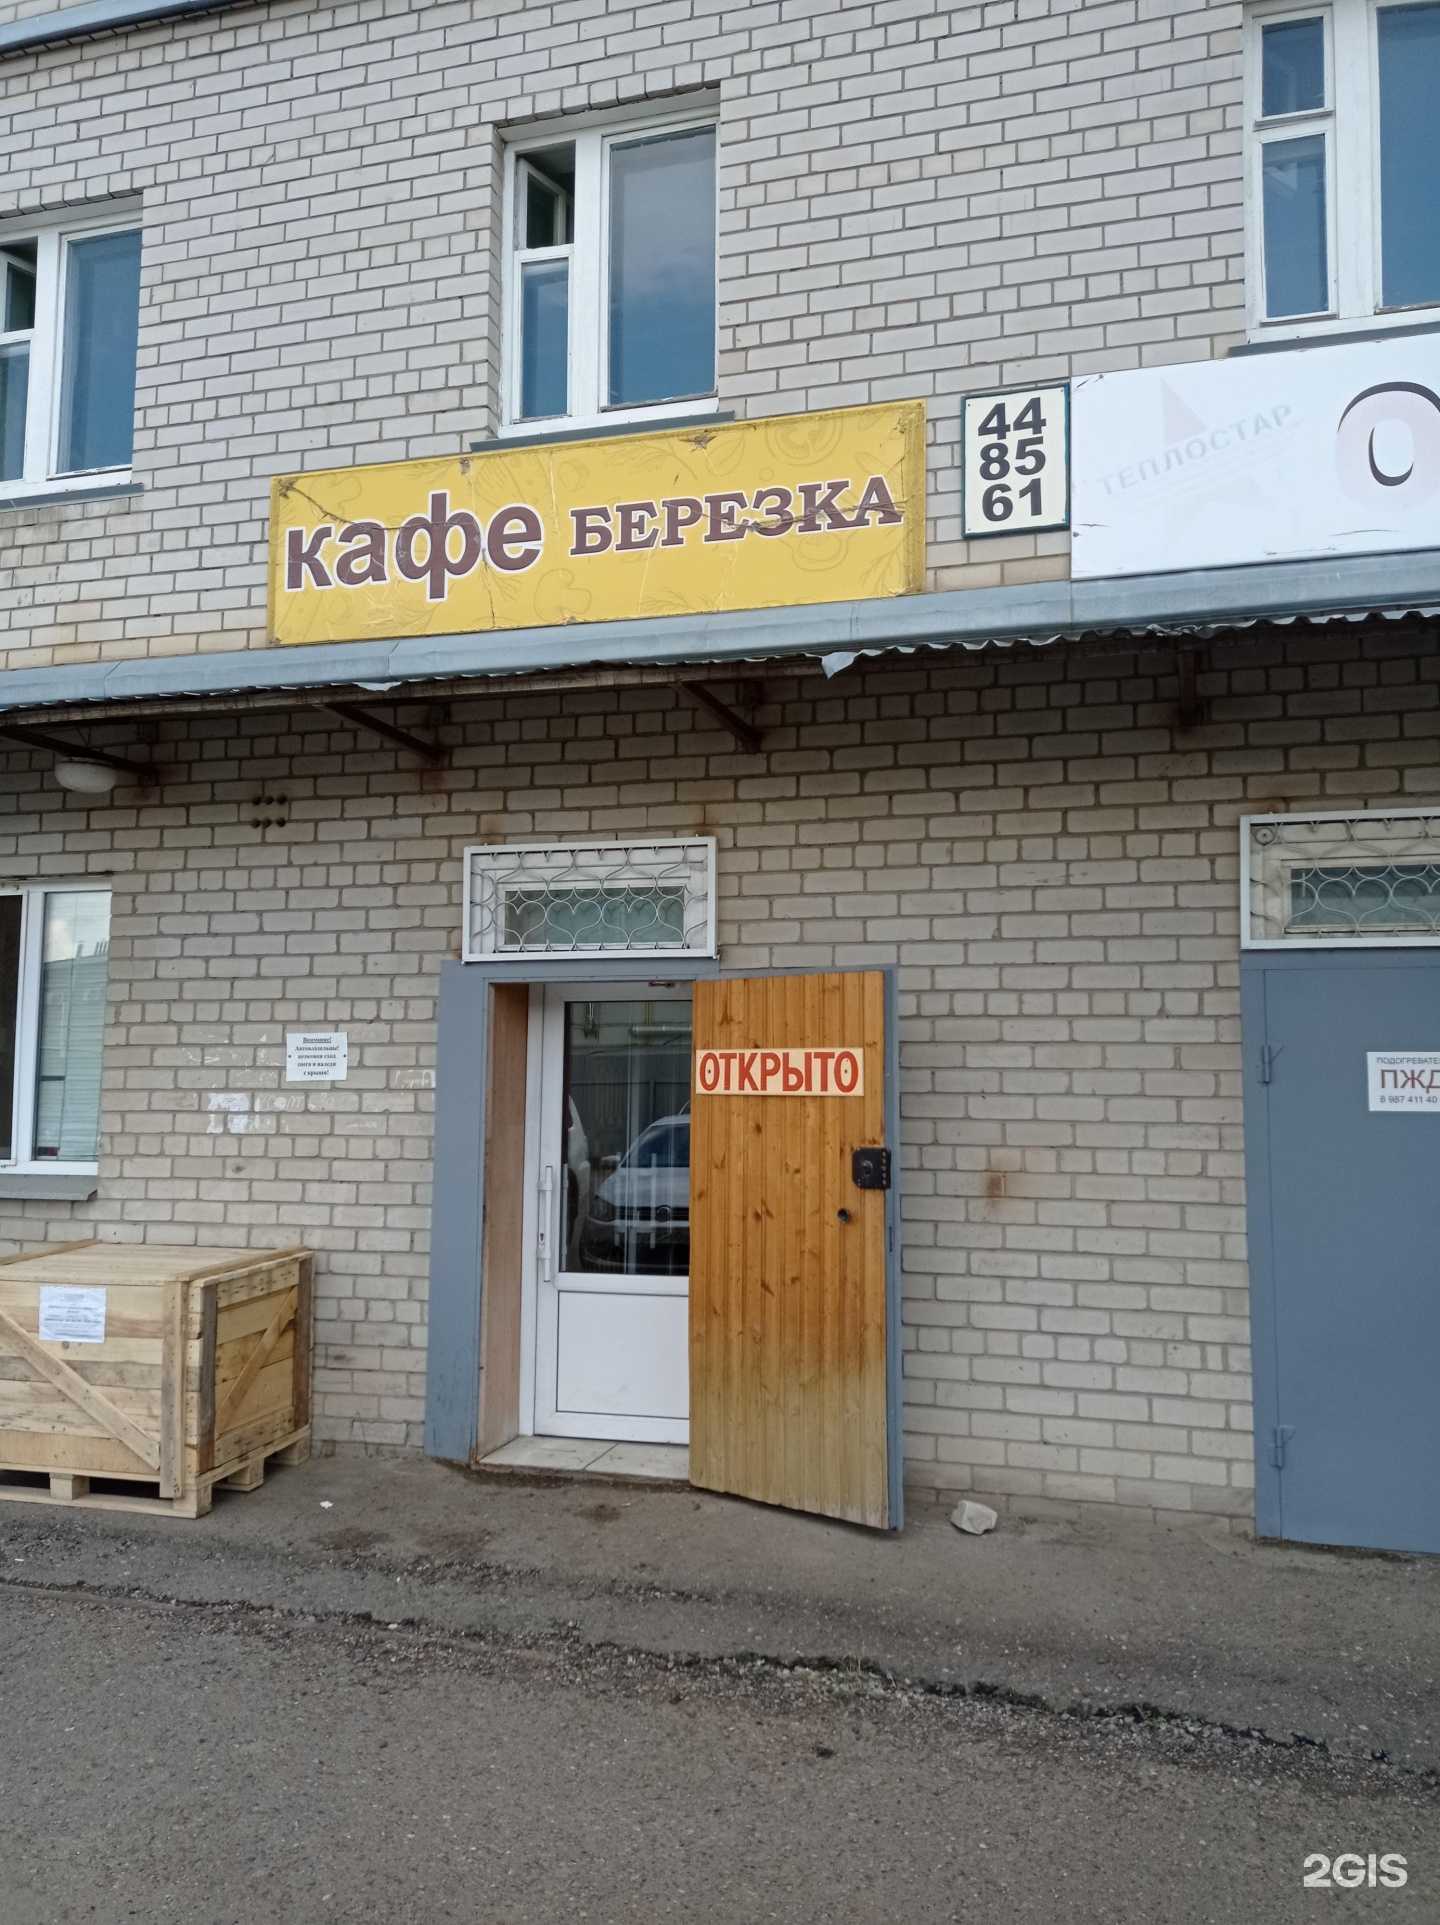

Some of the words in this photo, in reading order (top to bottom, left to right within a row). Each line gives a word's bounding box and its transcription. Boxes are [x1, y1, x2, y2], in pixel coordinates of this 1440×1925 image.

[977, 397, 1047, 441] 44
[978, 436, 1047, 481] 85
[1099, 404, 1294, 496] ТЕПЛОСТАР
[981, 478, 1043, 522] 61
[286, 492, 543, 600] кафе
[570, 476, 904, 556] БЕРЕЗКА
[699, 1050, 859, 1093] ОТКРЫТО
